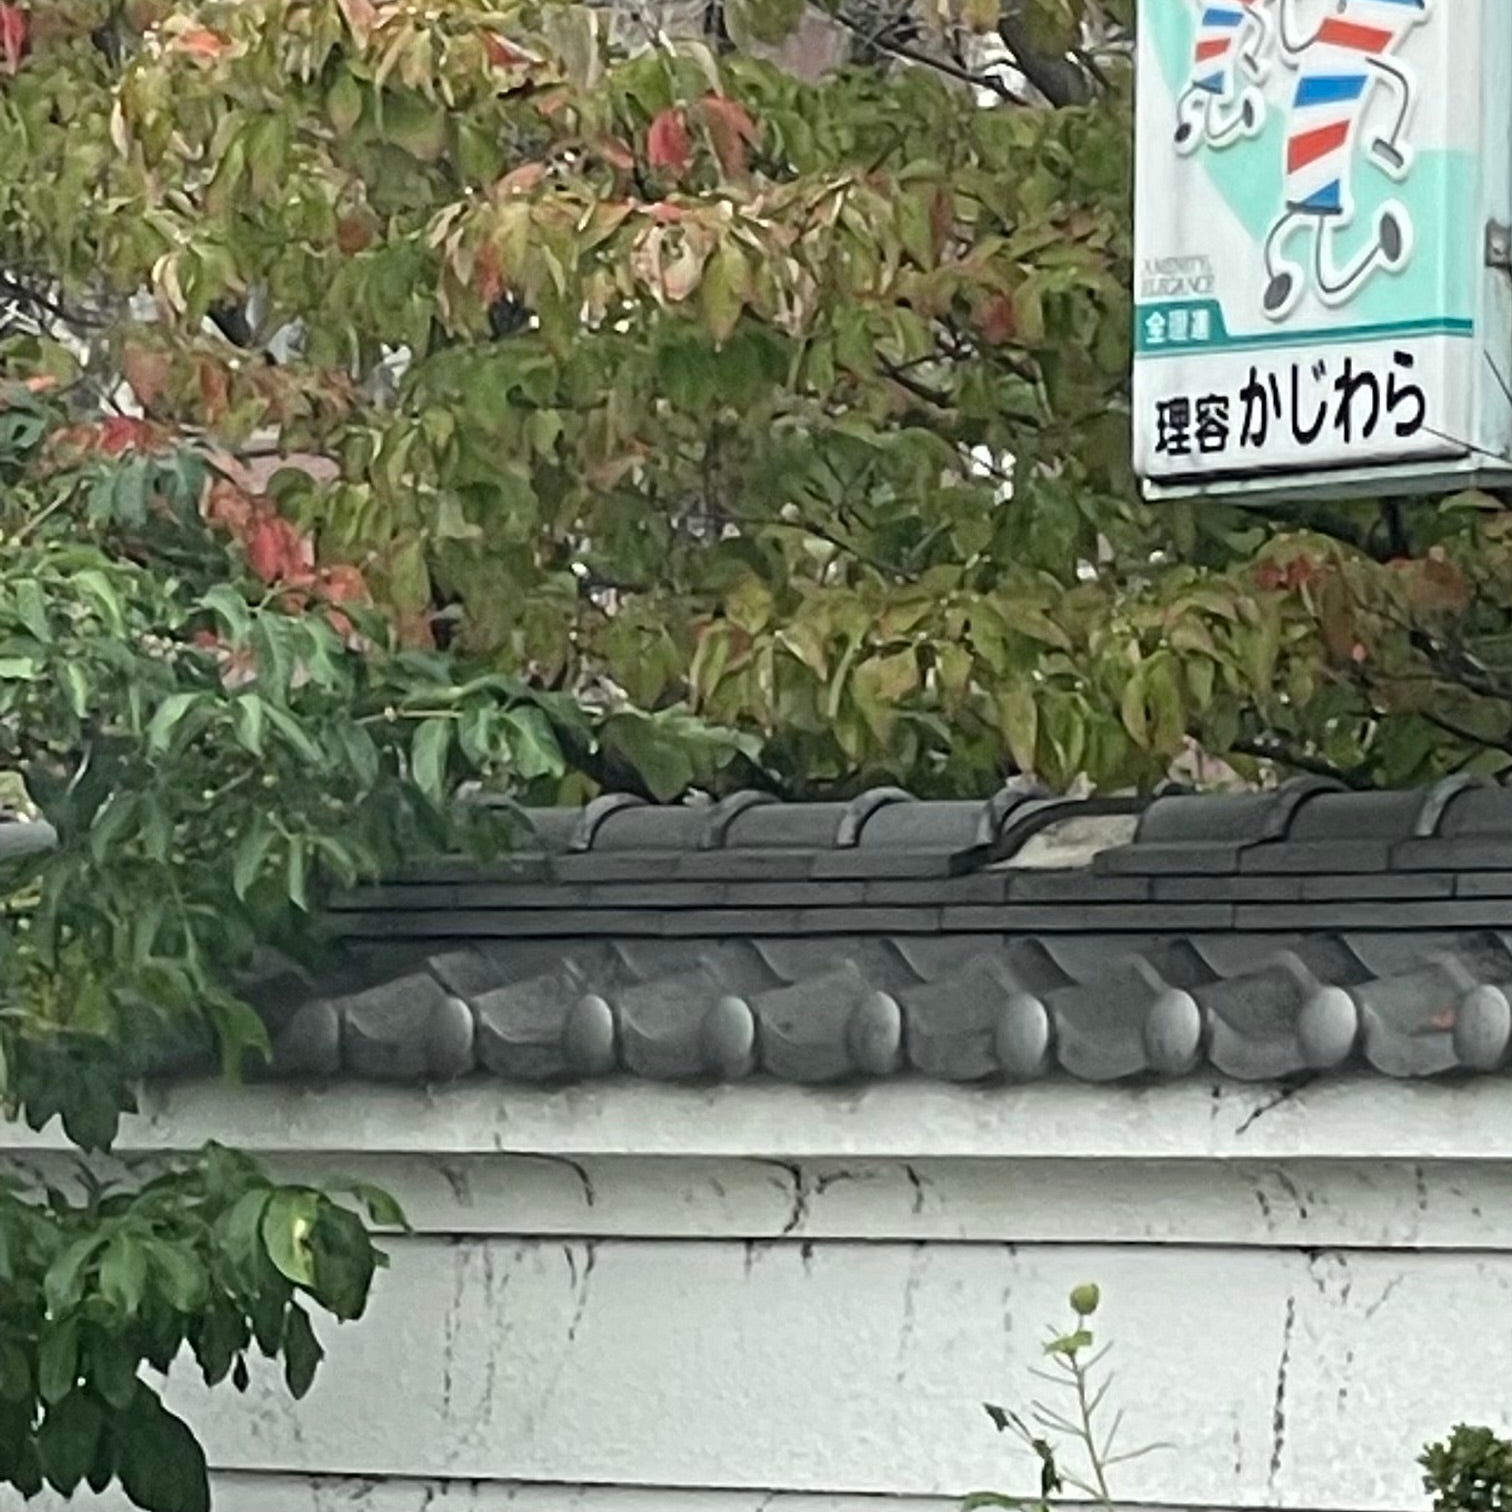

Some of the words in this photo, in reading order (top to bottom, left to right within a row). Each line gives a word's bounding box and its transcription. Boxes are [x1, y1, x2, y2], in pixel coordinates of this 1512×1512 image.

[1155, 350, 1426, 456] 理容かじわら
